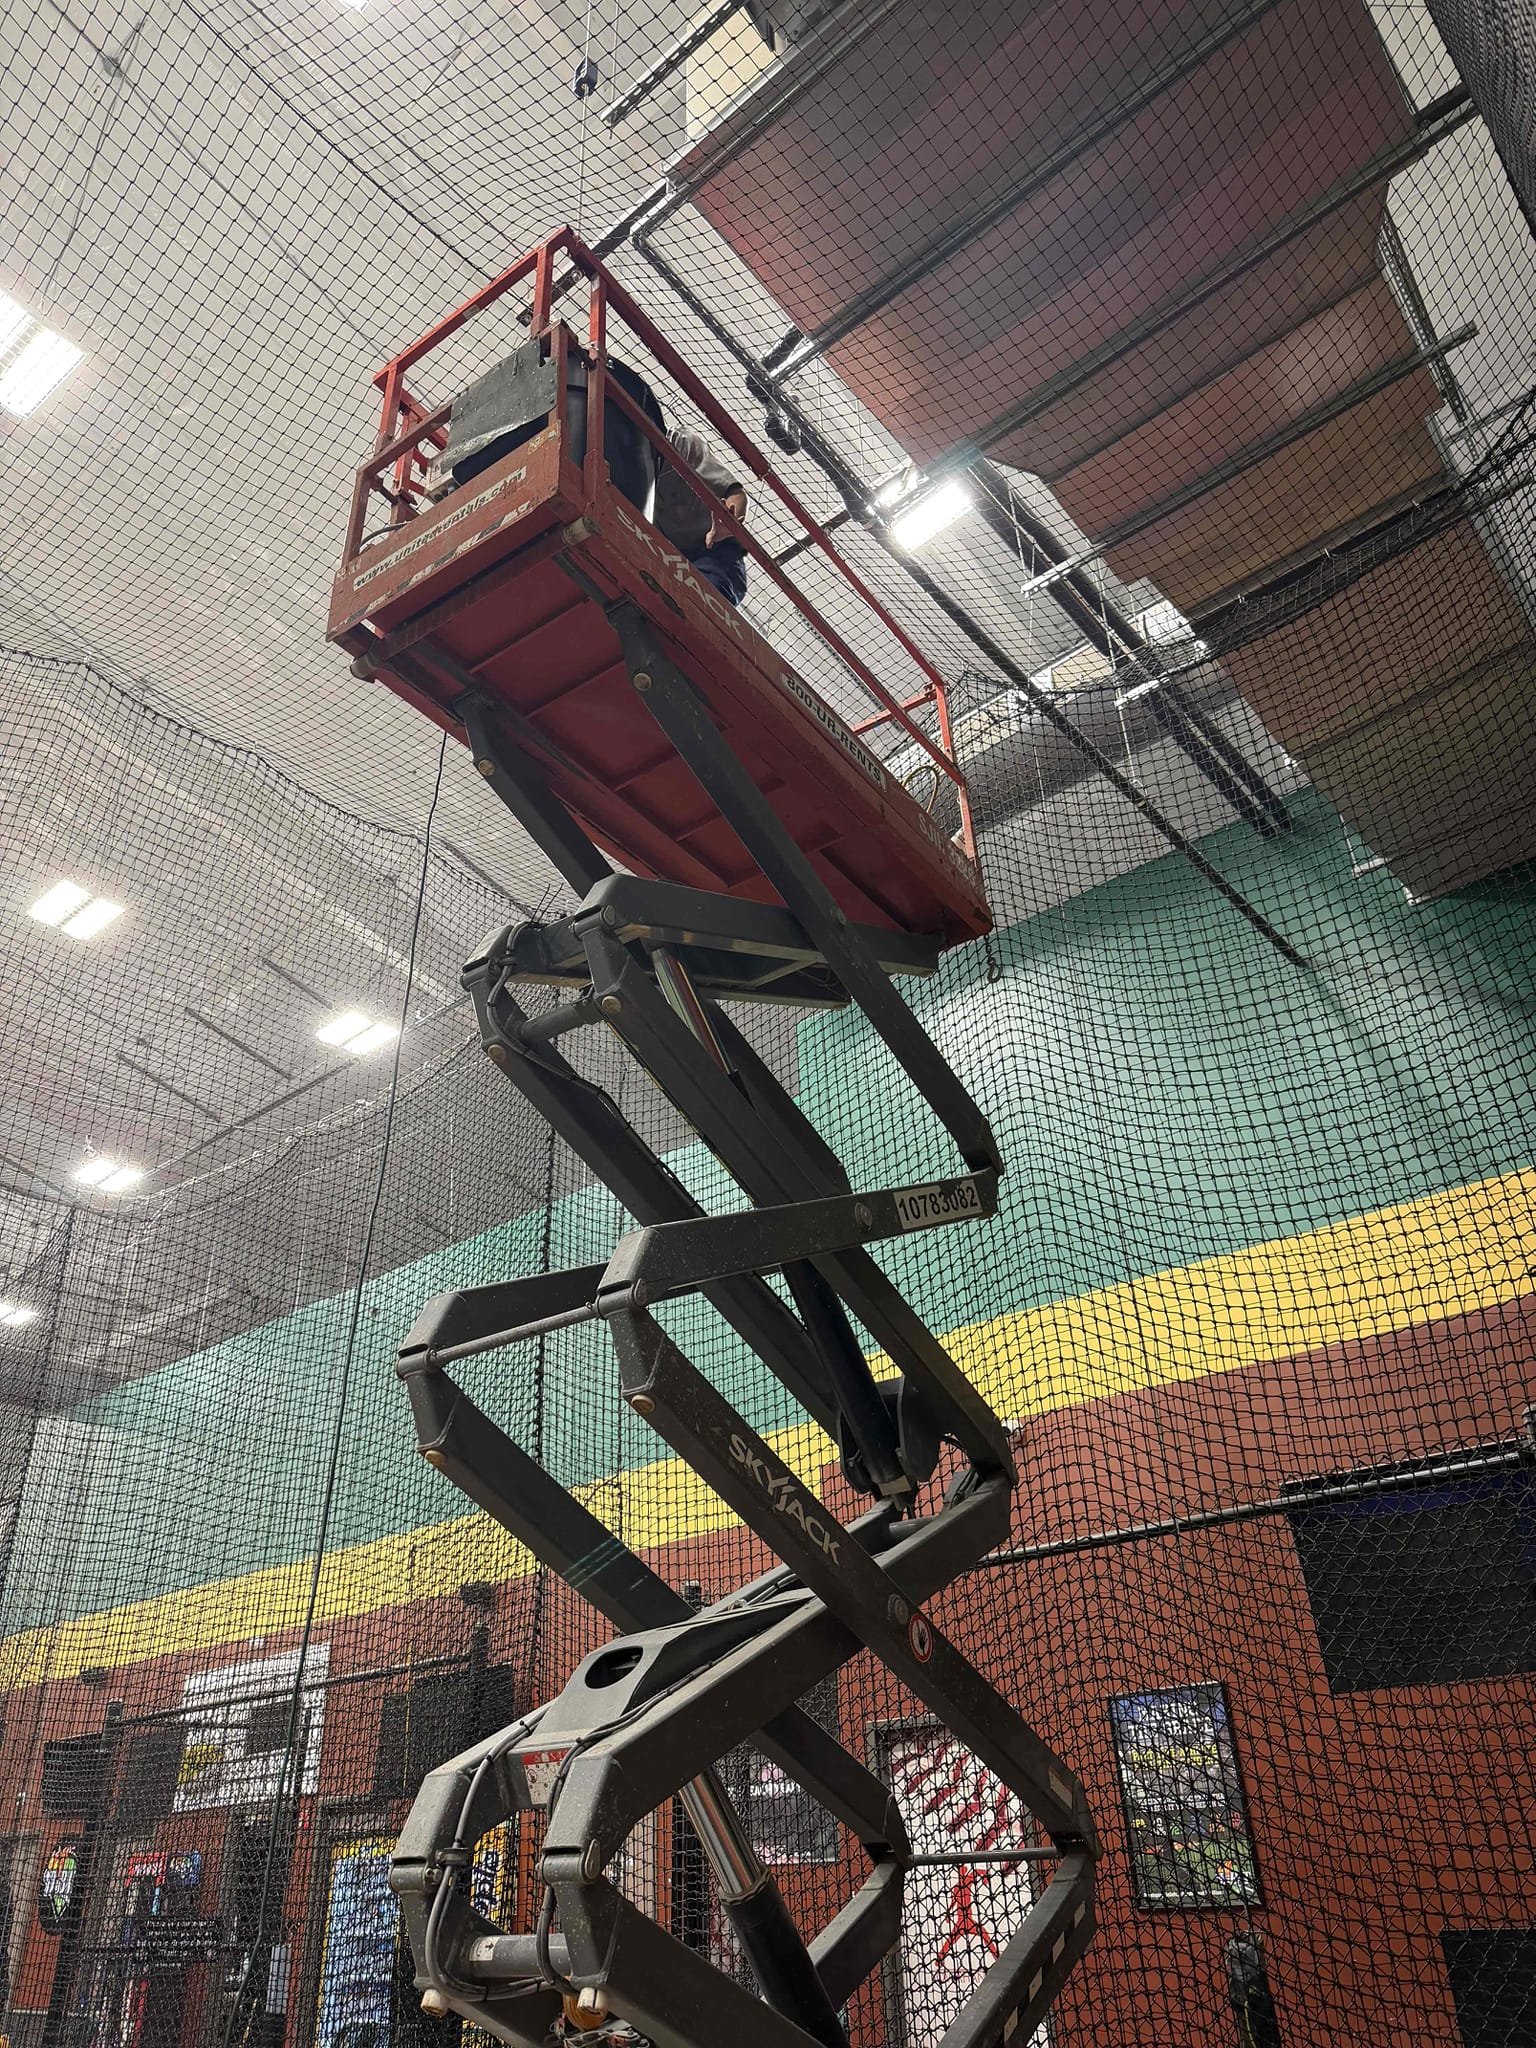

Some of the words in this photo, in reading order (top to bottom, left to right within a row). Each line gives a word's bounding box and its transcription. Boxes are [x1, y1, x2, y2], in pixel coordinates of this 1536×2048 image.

[616, 507, 745, 639] SKYJACK
[785, 675, 882, 783] 800-UR-RENTS
[898, 1185, 978, 1222] 10783082
[728, 1433, 841, 1567] SKYJACK
